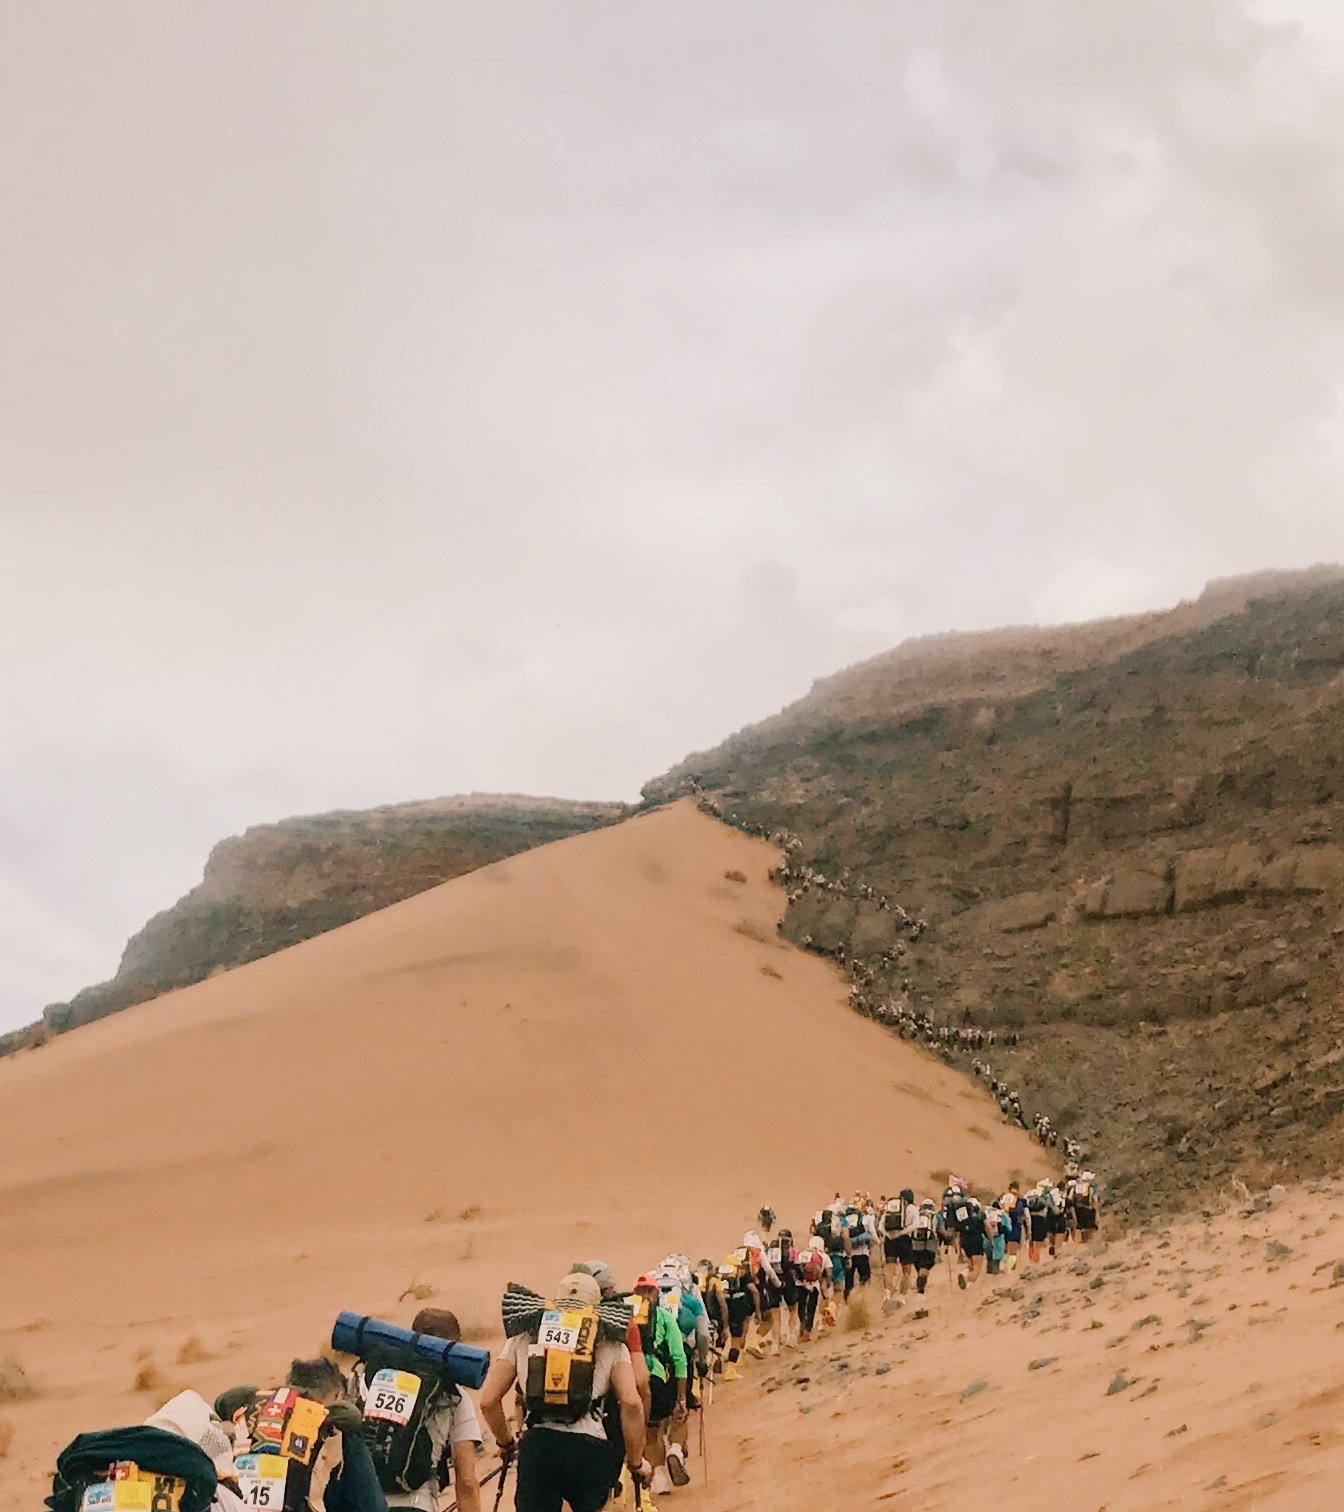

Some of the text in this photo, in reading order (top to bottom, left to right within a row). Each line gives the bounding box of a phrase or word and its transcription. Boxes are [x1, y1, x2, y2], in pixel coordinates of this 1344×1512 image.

[545, 1330, 570, 1345] 543
[375, 1393, 406, 1413] 526
[244, 1485, 270, 1506] 15
